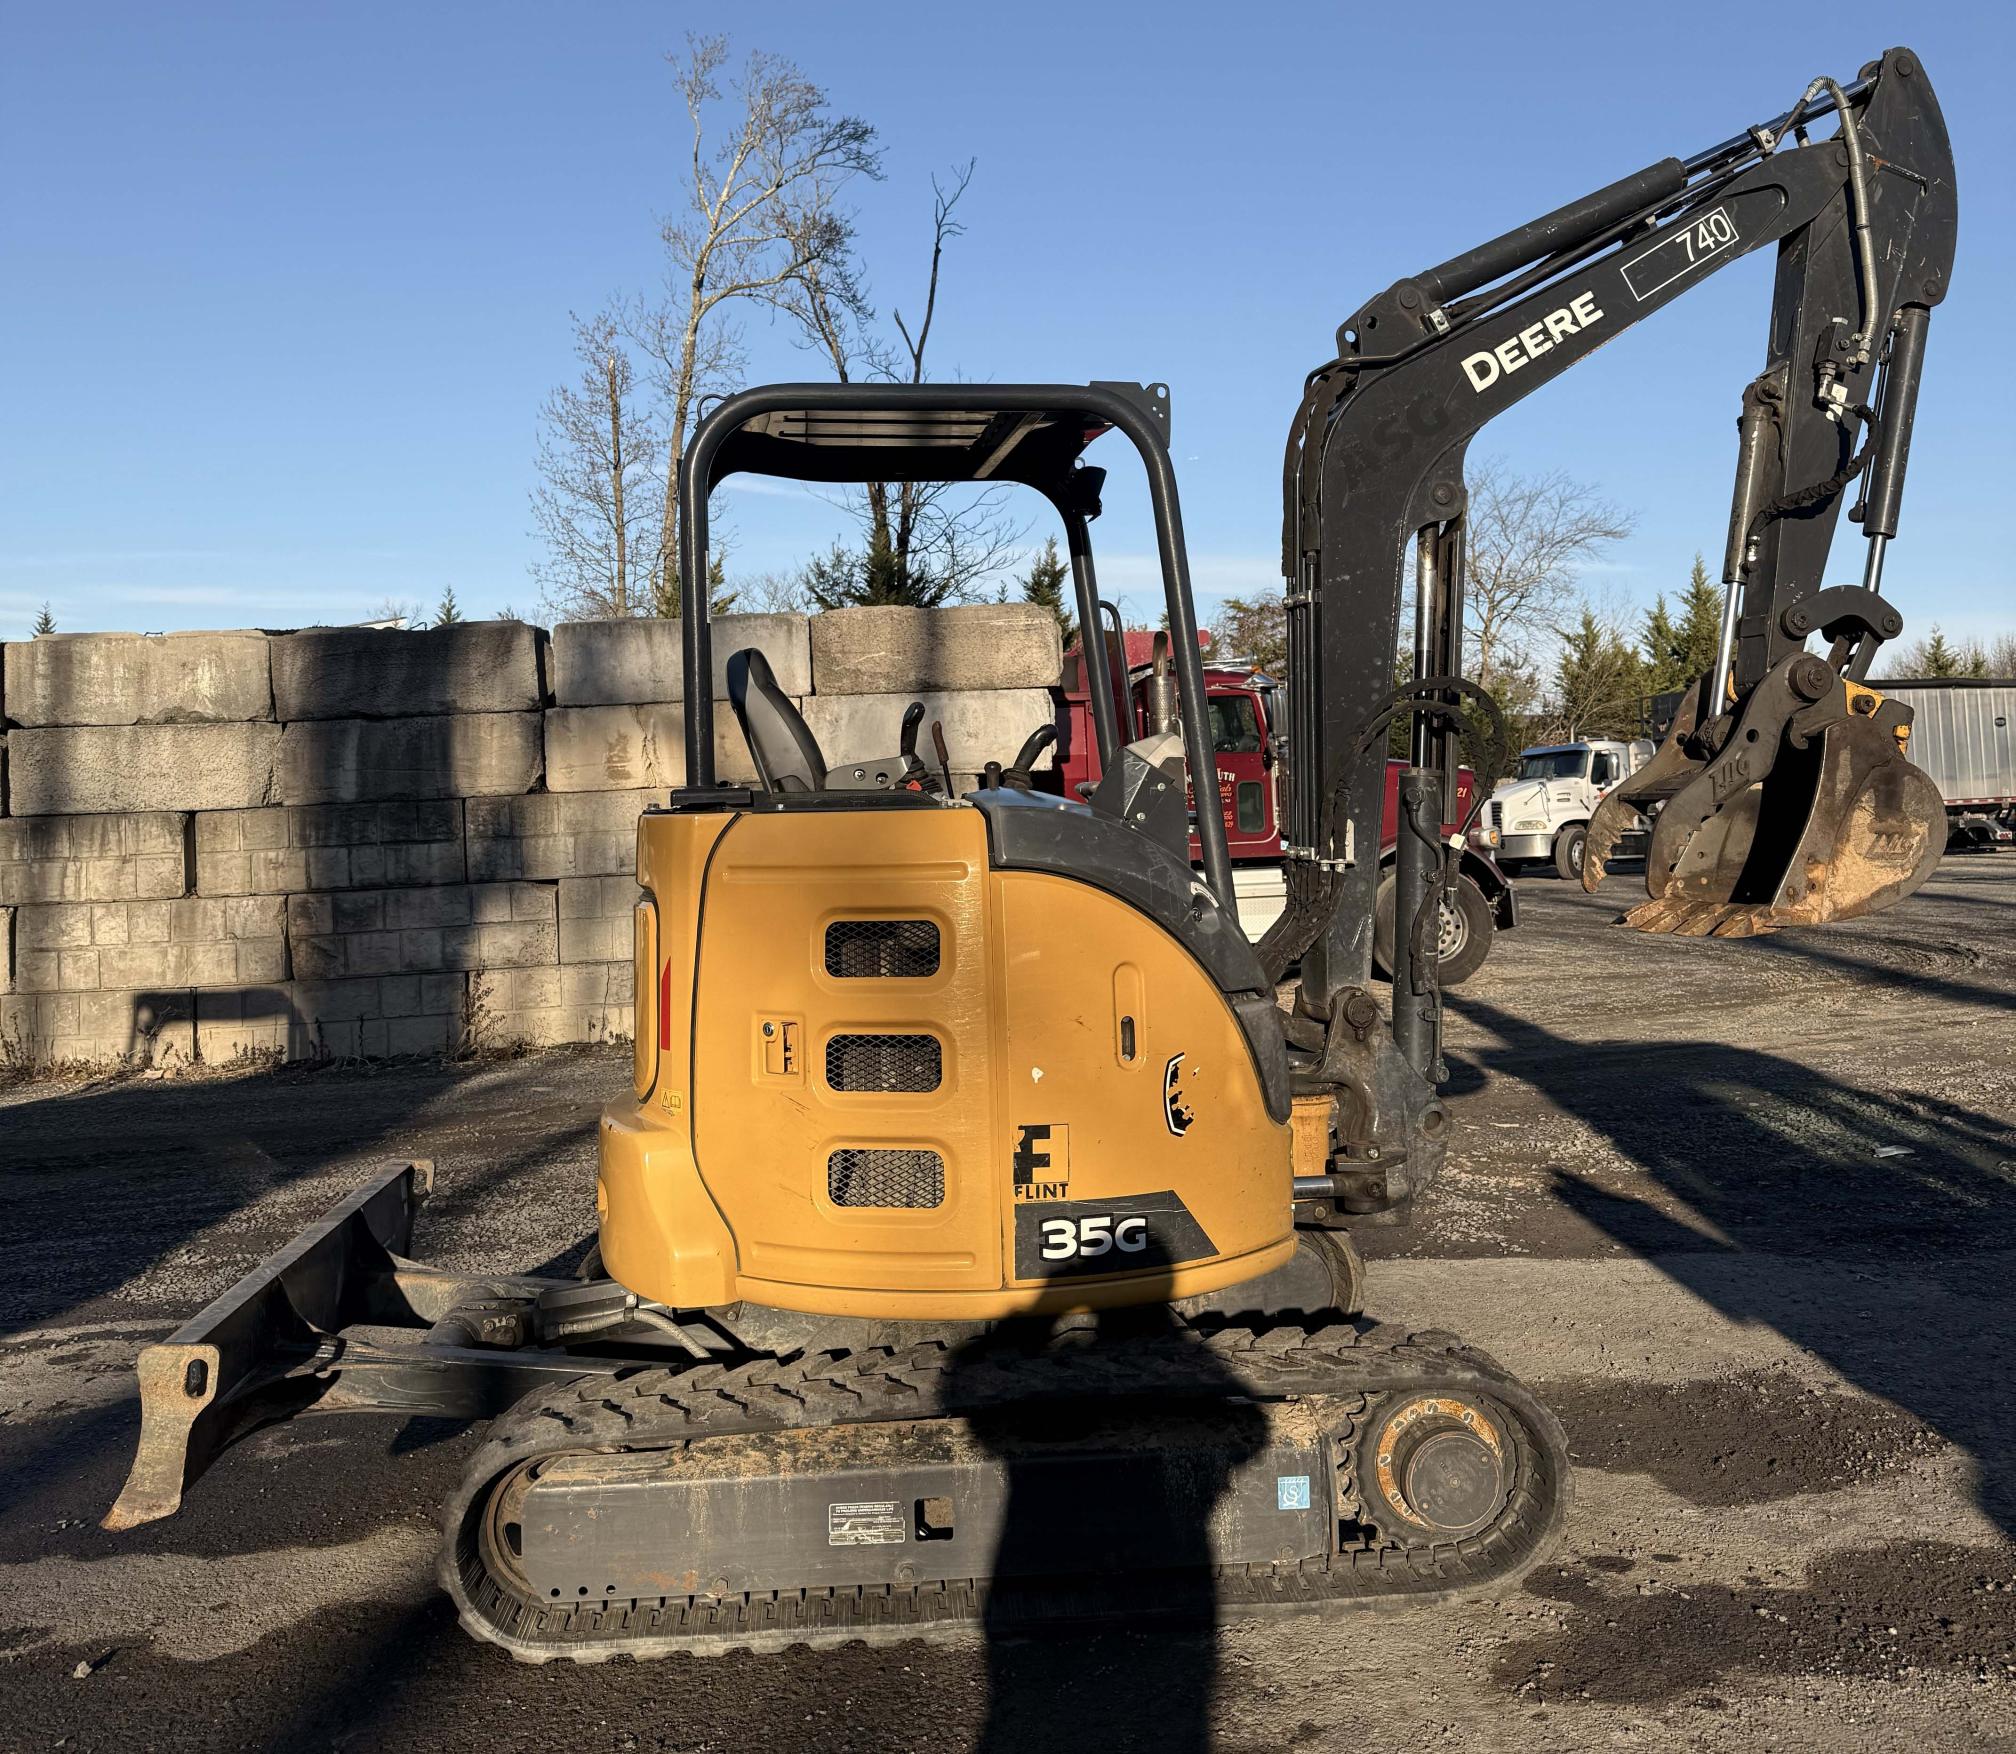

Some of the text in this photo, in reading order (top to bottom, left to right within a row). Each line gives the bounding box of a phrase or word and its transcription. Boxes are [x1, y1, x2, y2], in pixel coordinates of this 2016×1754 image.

[1675, 213, 1731, 262] 740
[1460, 290, 1605, 393] DEERE
[1014, 1183, 1069, 1200] FLINT
[1041, 1215, 1147, 1260] 35G
